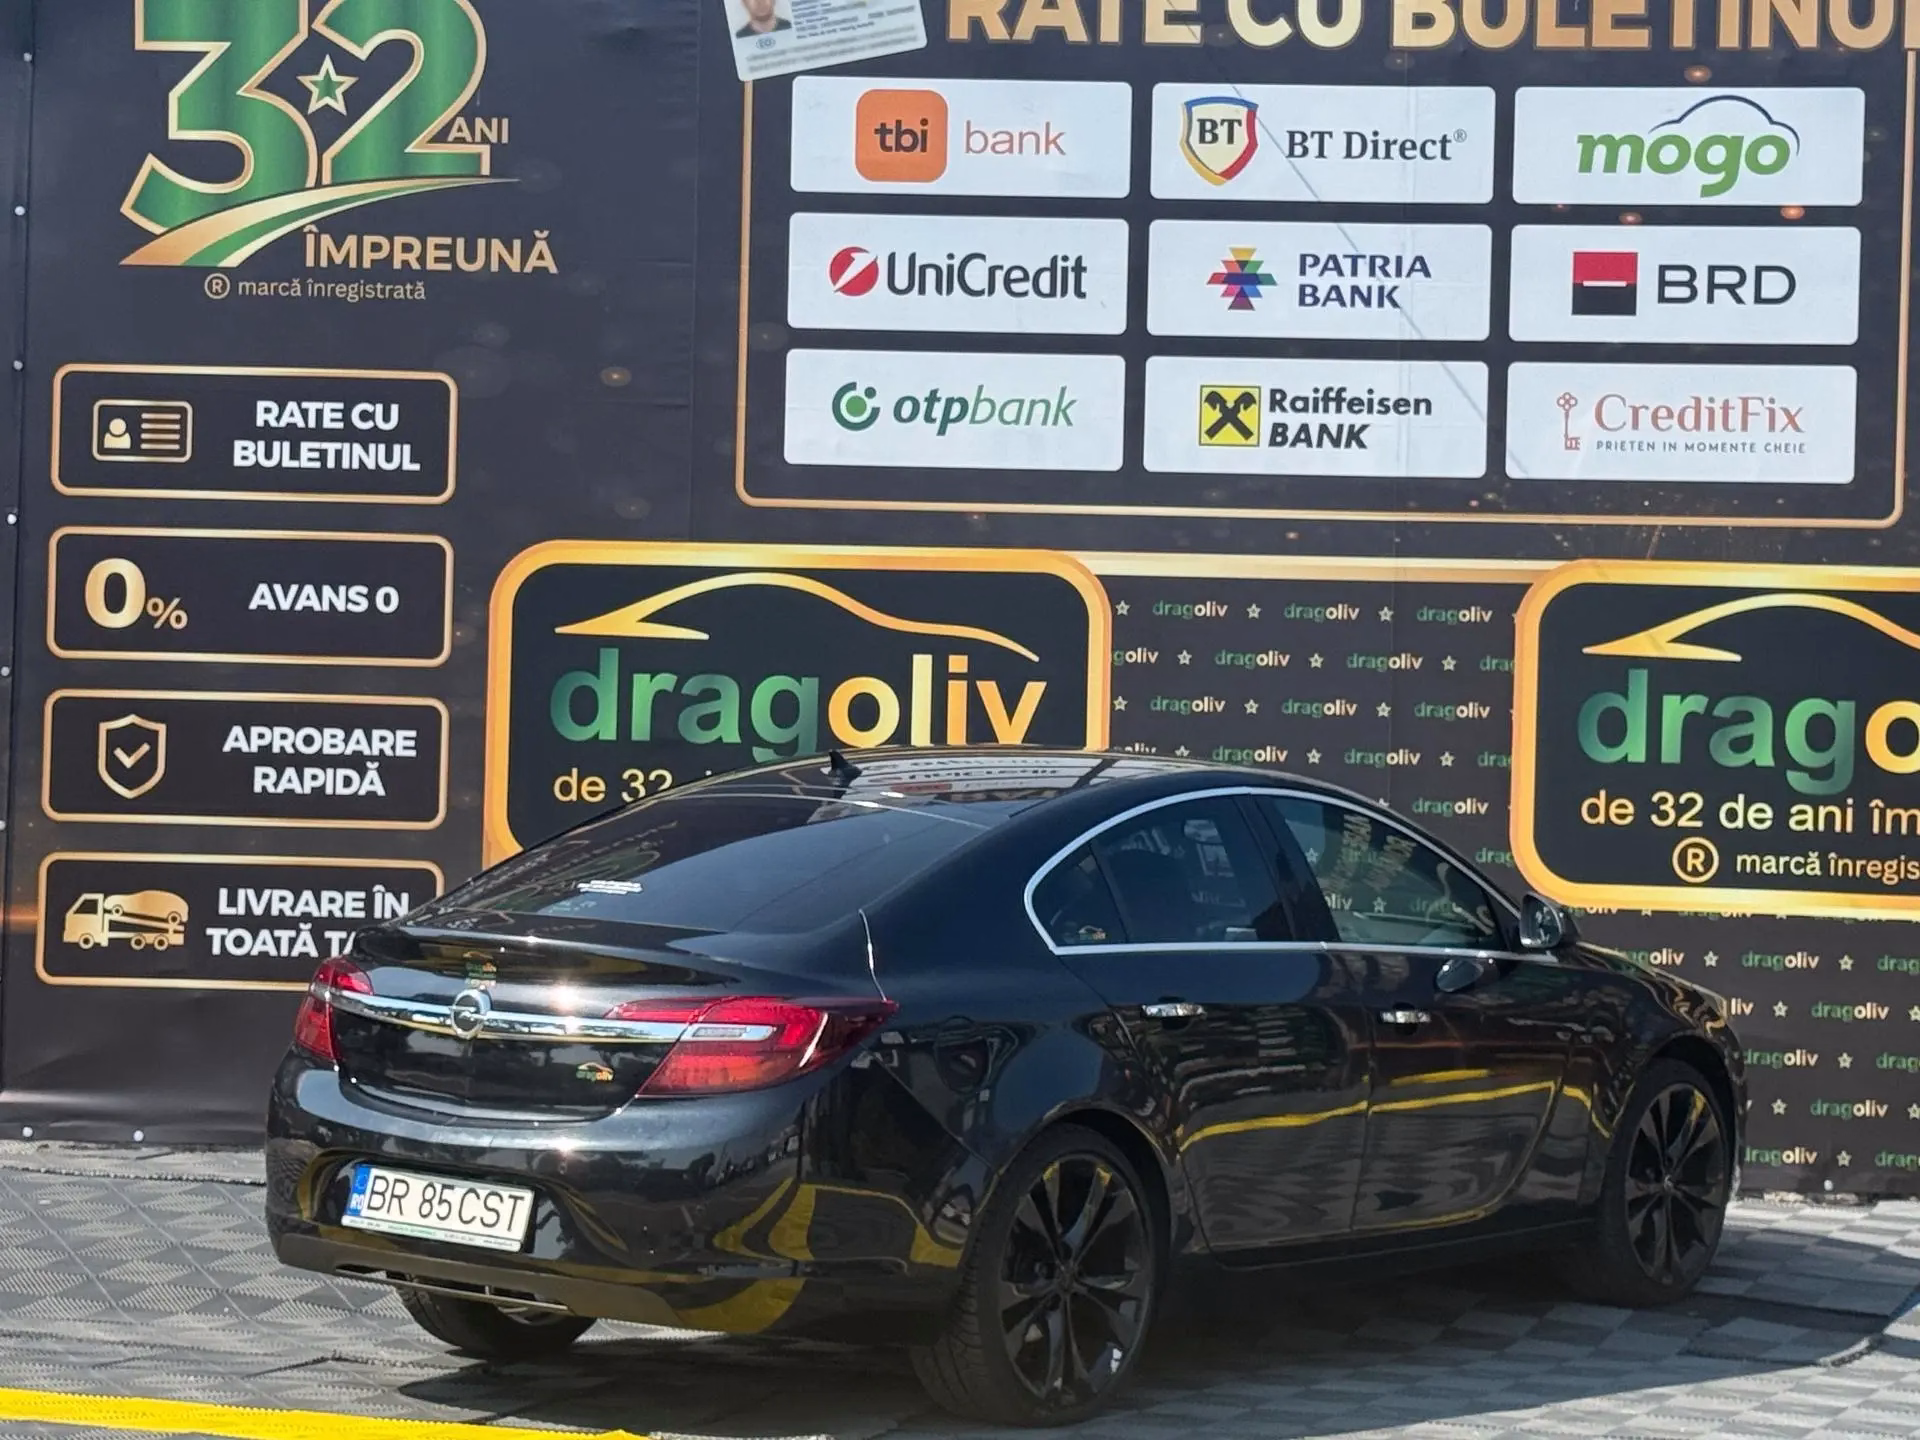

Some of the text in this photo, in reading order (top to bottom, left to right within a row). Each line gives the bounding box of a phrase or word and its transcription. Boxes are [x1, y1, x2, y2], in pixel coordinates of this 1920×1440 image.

[120, 0, 489, 235] 32
[448, 117, 509, 144] ANI
[1197, 119, 1242, 144] BT
[874, 118, 1066, 155] tbi bank
[1286, 131, 1333, 158] BT
[1577, 133, 1791, 198] mogo
[304, 225, 558, 274] ÎMPREUNĂ
[887, 252, 1087, 299] UniCredit
[1300, 254, 1431, 278] PATRIA
[239, 278, 301, 296] marcă
[307, 278, 426, 302] înregistrată
[1299, 284, 1401, 309] BANK
[1658, 264, 1796, 305] BRD
[256, 400, 399, 430] RATE CU
[893, 385, 1076, 436] otpbank
[1269, 387, 1432, 415] Raiffeisen
[1595, 394, 1804, 433] CreditFix
[1268, 423, 1370, 449] BANK
[1596, 440, 1804, 453] PRIETEN IN MOMENTE CHEIE
[234, 440, 420, 471] BULETINUL
[249, 583, 399, 613] AVANS 0
[1152, 600, 1493, 626] dragoliv dragoliv dragoliv
[1214, 649, 1291, 669] dragoliv
[1346, 651, 1424, 672] dragoliv
[550, 646, 1048, 762] dragoliv
[1150, 695, 1491, 721] dragoliv dragoliv dragoliv
[223, 726, 417, 757] APROBARE
[1212, 745, 1289, 766] dragoliv
[1344, 748, 1421, 769] dragoliv
[254, 761, 385, 796] RAPIDĂ
[554, 768, 605, 802] de
[1411, 797, 1489, 818] dragoliv
[1581, 789, 1634, 825] de
[1651, 791, 1703, 827] 32
[1719, 794, 1773, 830] de
[1789, 798, 1853, 832] ani
[1737, 851, 1821, 875] marcă
[219, 884, 409, 919] LIVRARE ÎN
[206, 923, 318, 957] TOATĂ
[1741, 950, 1819, 971] dragoliv
[1811, 1001, 1889, 1022] dragoliv
[1876, 1052, 1920, 1073] drag
[1810, 1099, 1889, 1120] dragoliv
[1874, 1150, 1920, 1171] drag
[366, 1175, 410, 1217] BR
